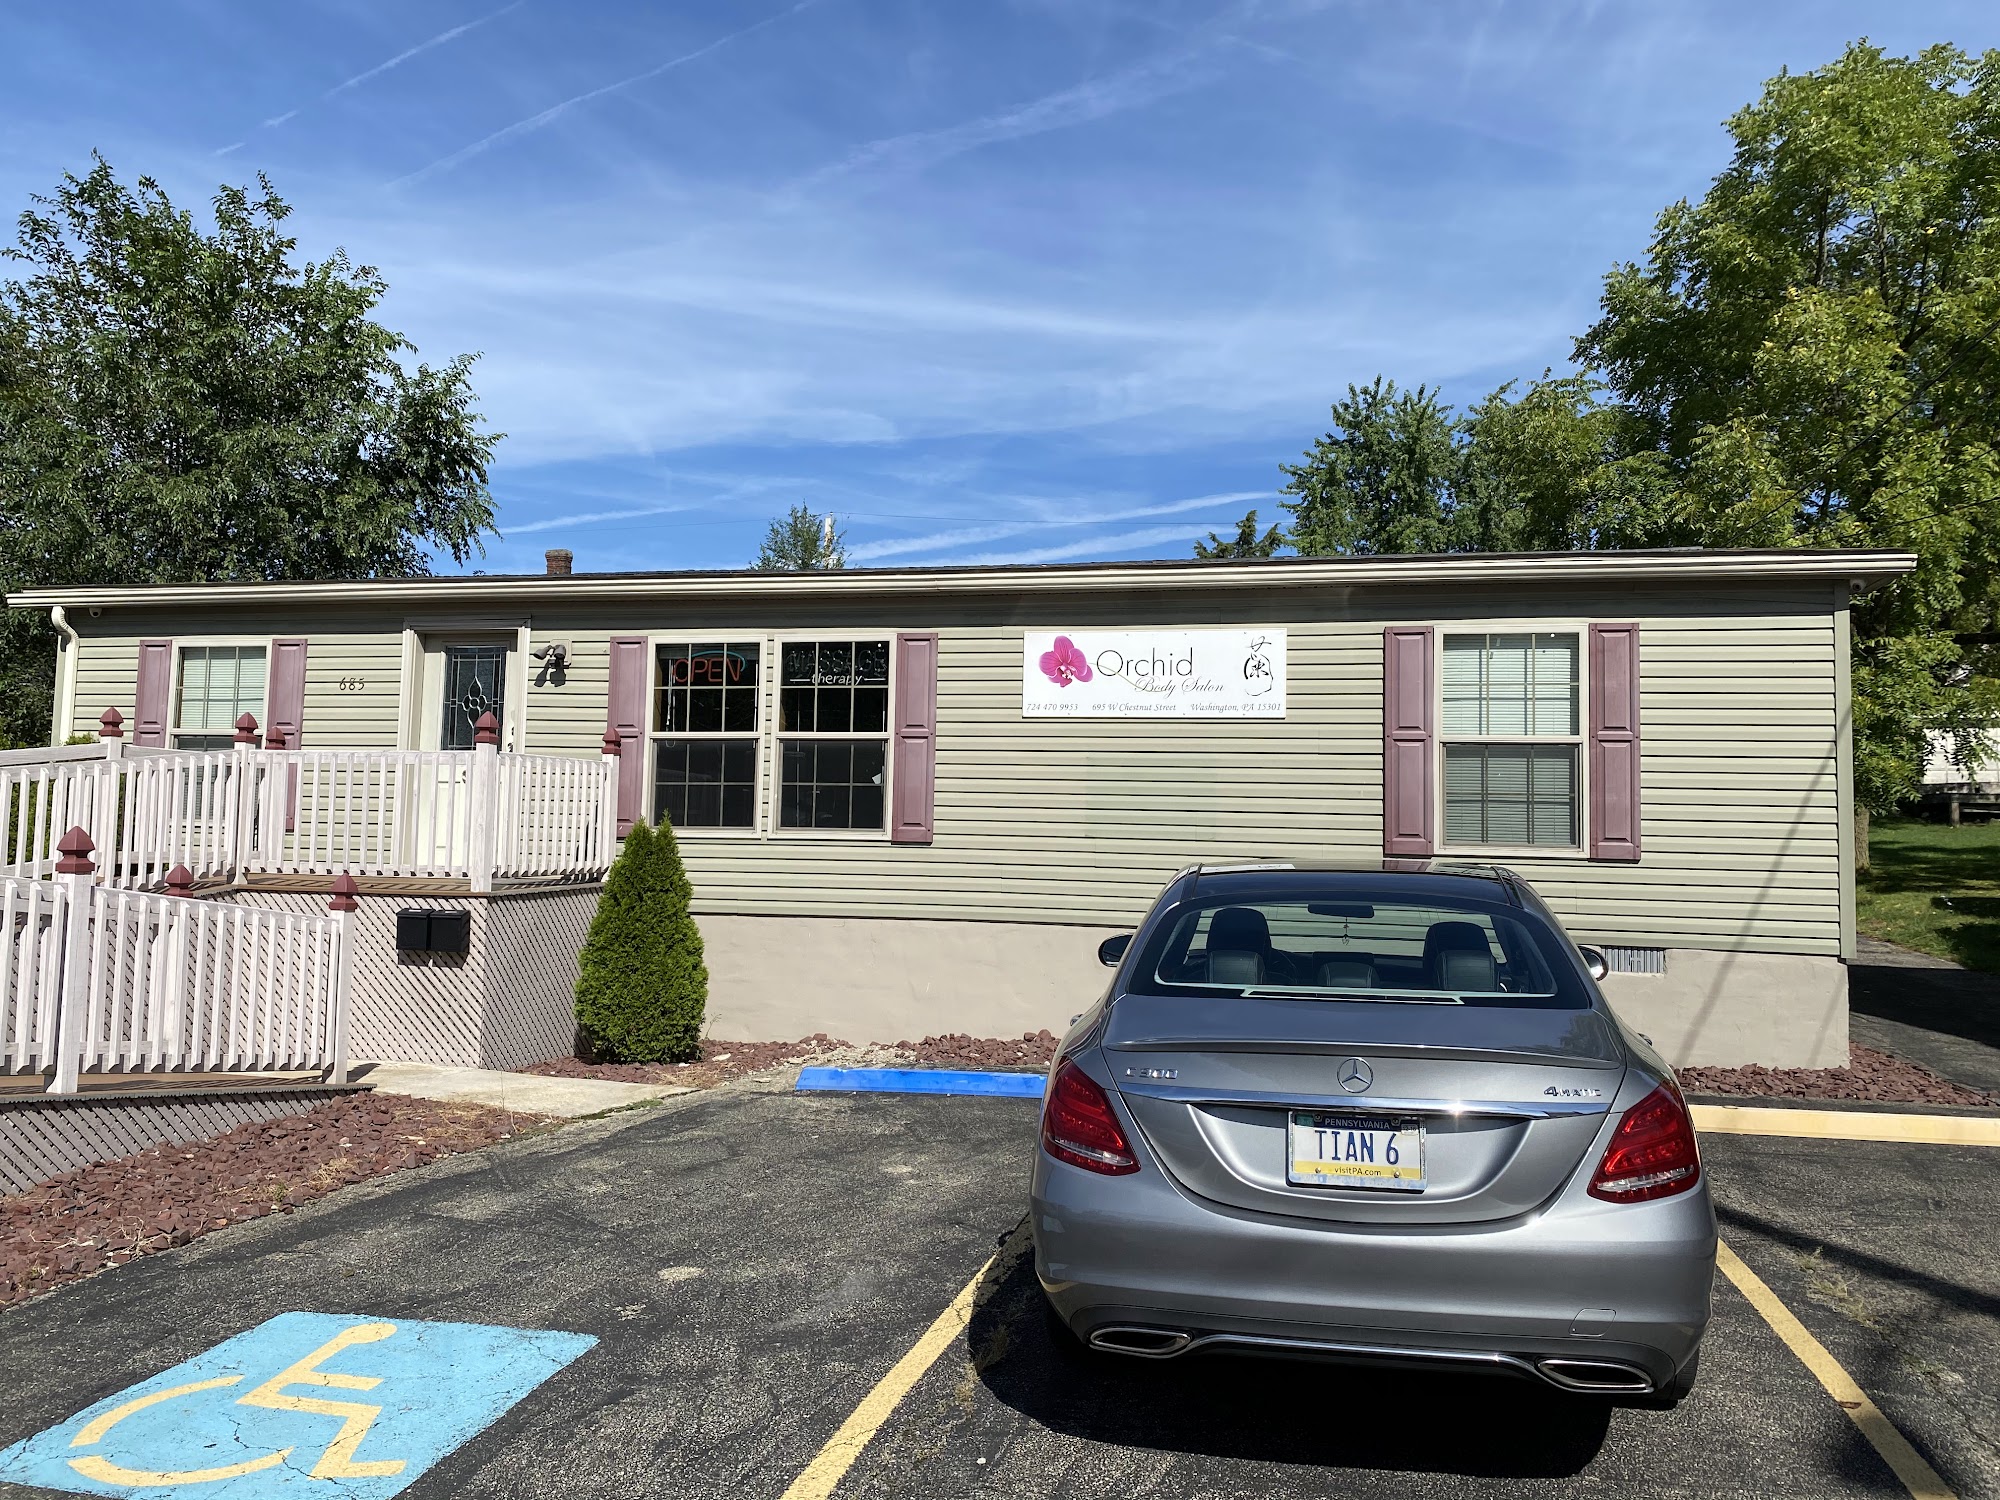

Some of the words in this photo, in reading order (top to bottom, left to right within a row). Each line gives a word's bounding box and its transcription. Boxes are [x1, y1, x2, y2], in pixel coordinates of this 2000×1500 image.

[1096, 647, 1193, 677] Orchid
[674, 658, 741, 683] OPEN
[339, 676, 365, 691] 685
[811, 673, 862, 686] therapy
[1134, 678, 1177, 699] Body
[1181, 677, 1224, 692] Salon
[1026, 703, 1041, 711] 724
[1043, 703, 1057, 711] 470
[1059, 703, 1079, 711] 9953
[1092, 703, 1106, 711] 695
[1108, 703, 1118, 711] W
[1119, 702, 1152, 712] Chestnut
[1154, 703, 1176, 711] Street
[1190, 702, 1239, 713] Washington,
[1241, 703, 1255, 712] PA
[1257, 703, 1281, 711] 15301
[1543, 1086, 1601, 1097] 4MATIC
[1324, 1117, 1390, 1130] PENNSYLVANIA
[1315, 1129, 1374, 1163] TIAN
[1386, 1132, 1399, 1166] 6
[1334, 1166, 1382, 1177] visitPA.com
